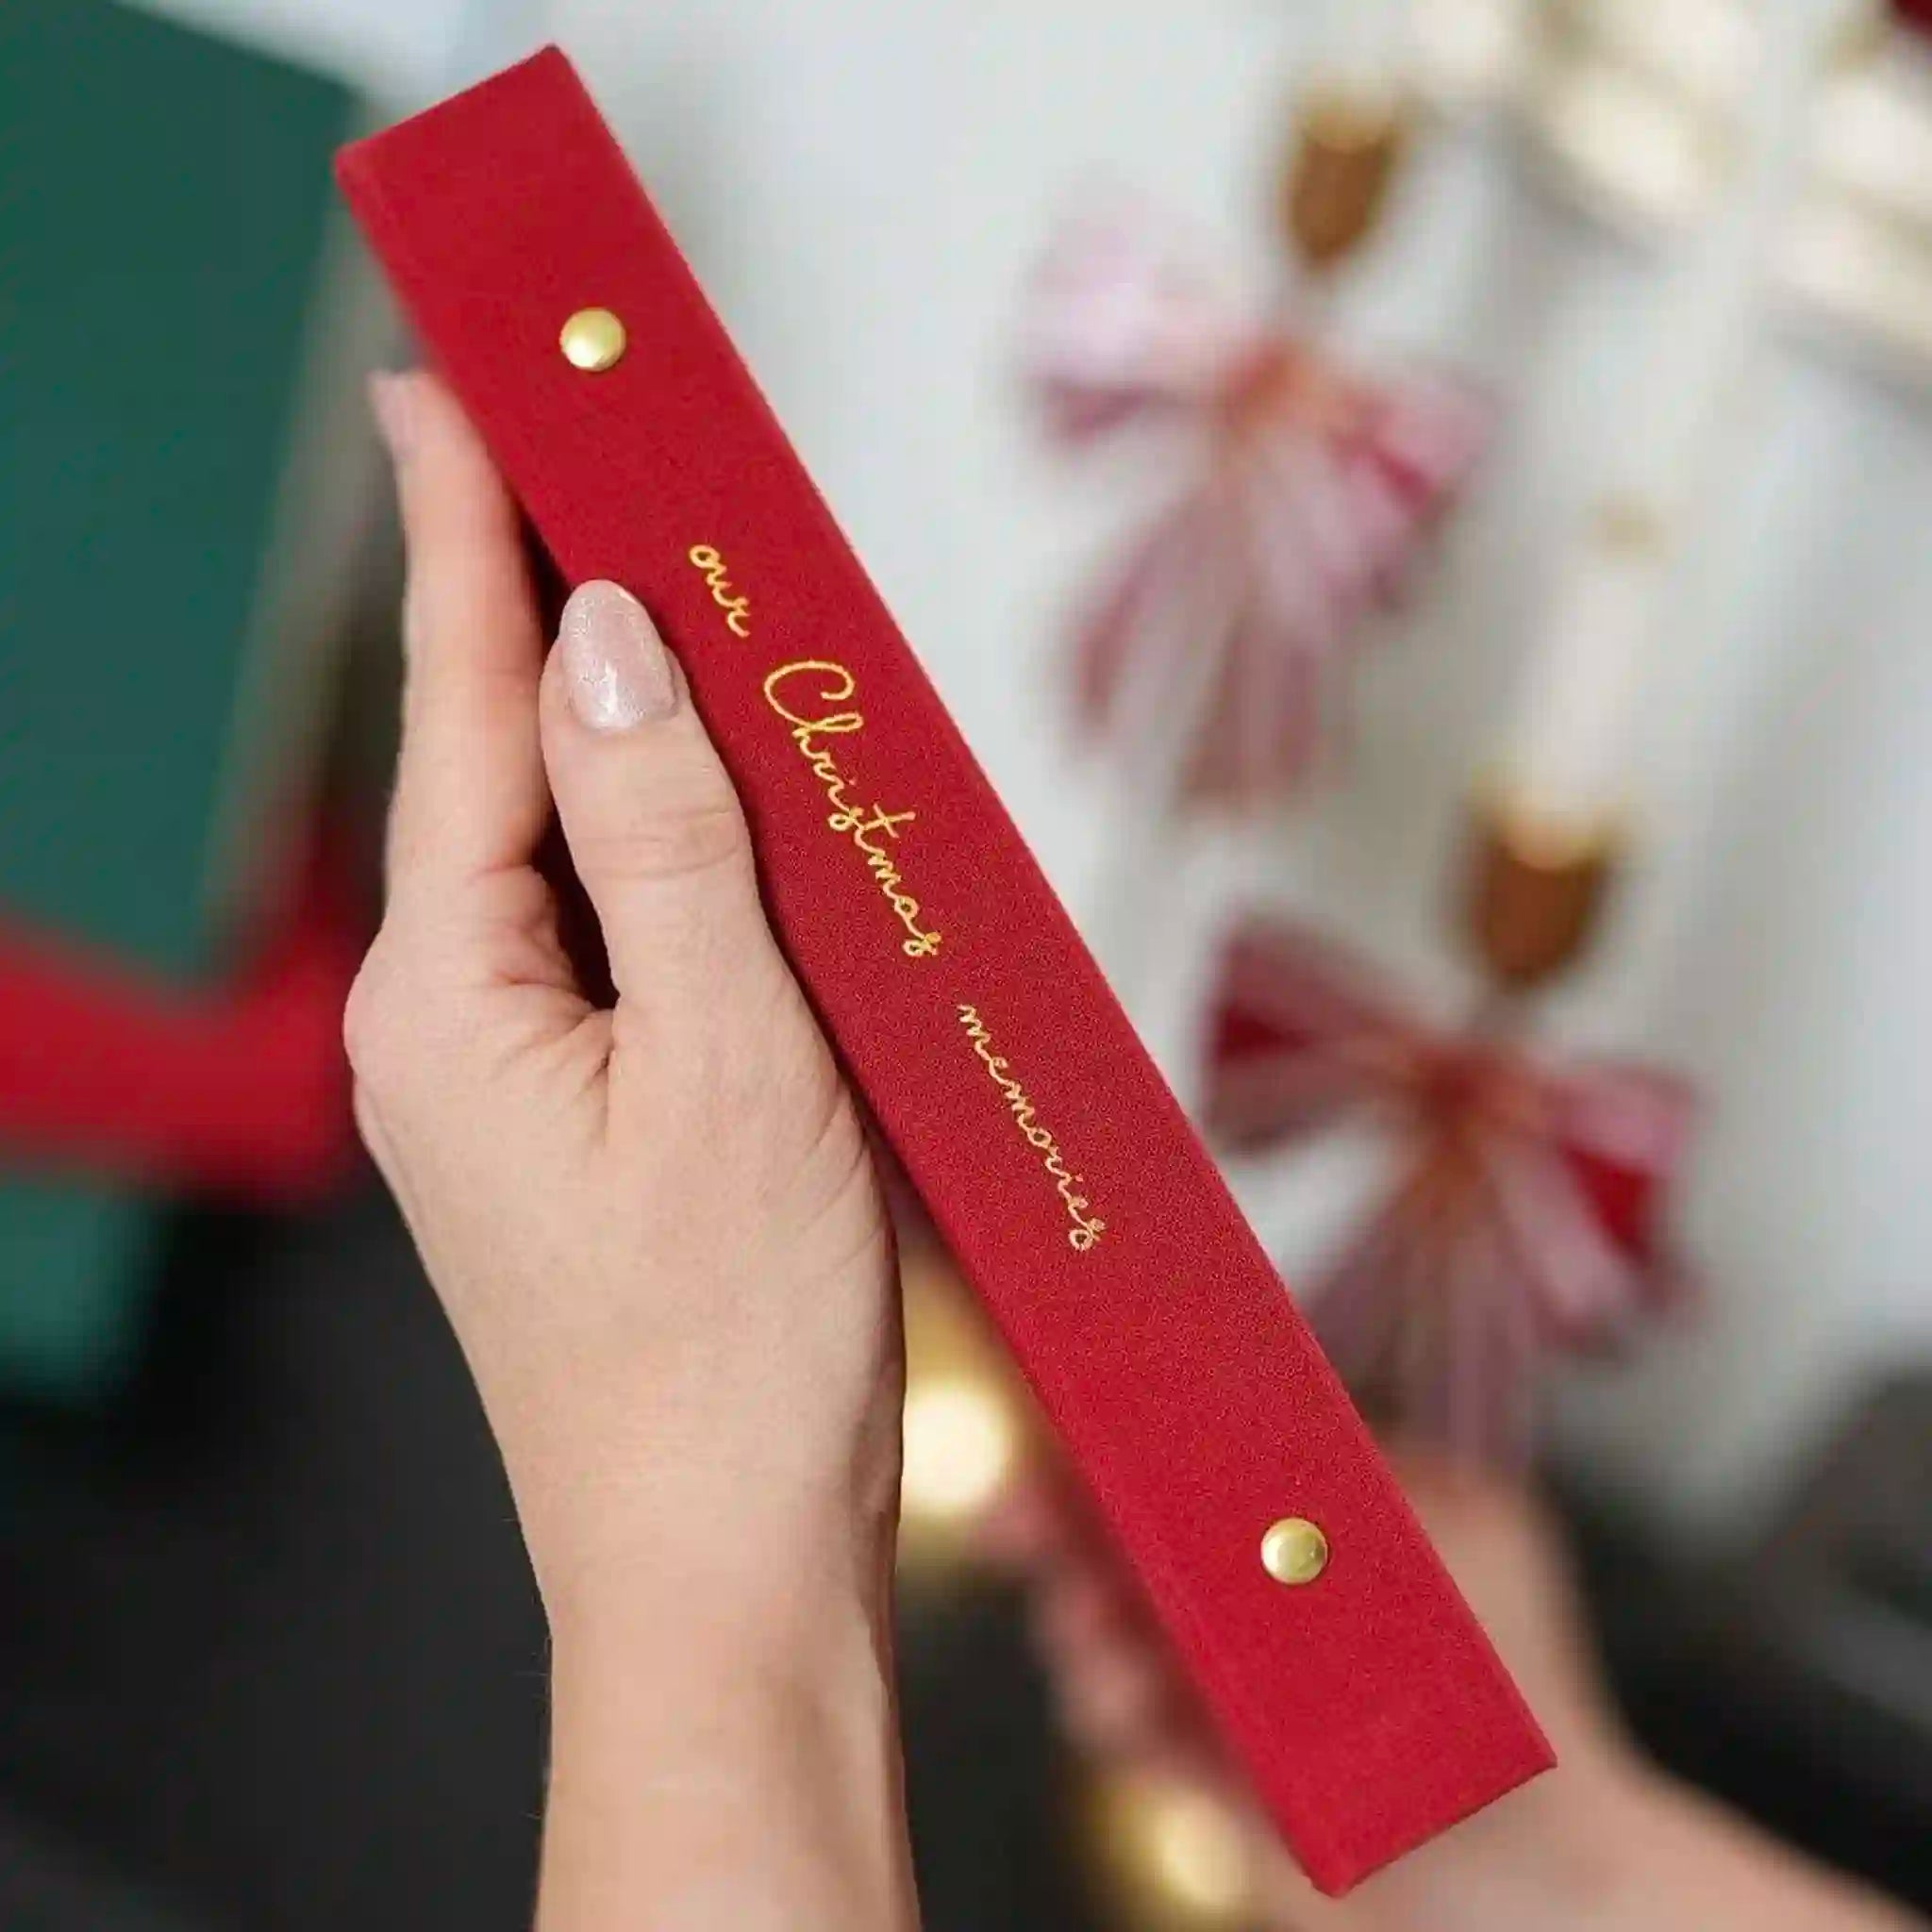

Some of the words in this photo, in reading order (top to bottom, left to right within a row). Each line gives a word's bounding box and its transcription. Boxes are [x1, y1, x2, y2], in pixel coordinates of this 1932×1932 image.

[688, 543, 751, 639] our
[762, 658, 943, 958] Christmas
[957, 1003, 1108, 1254] memories
